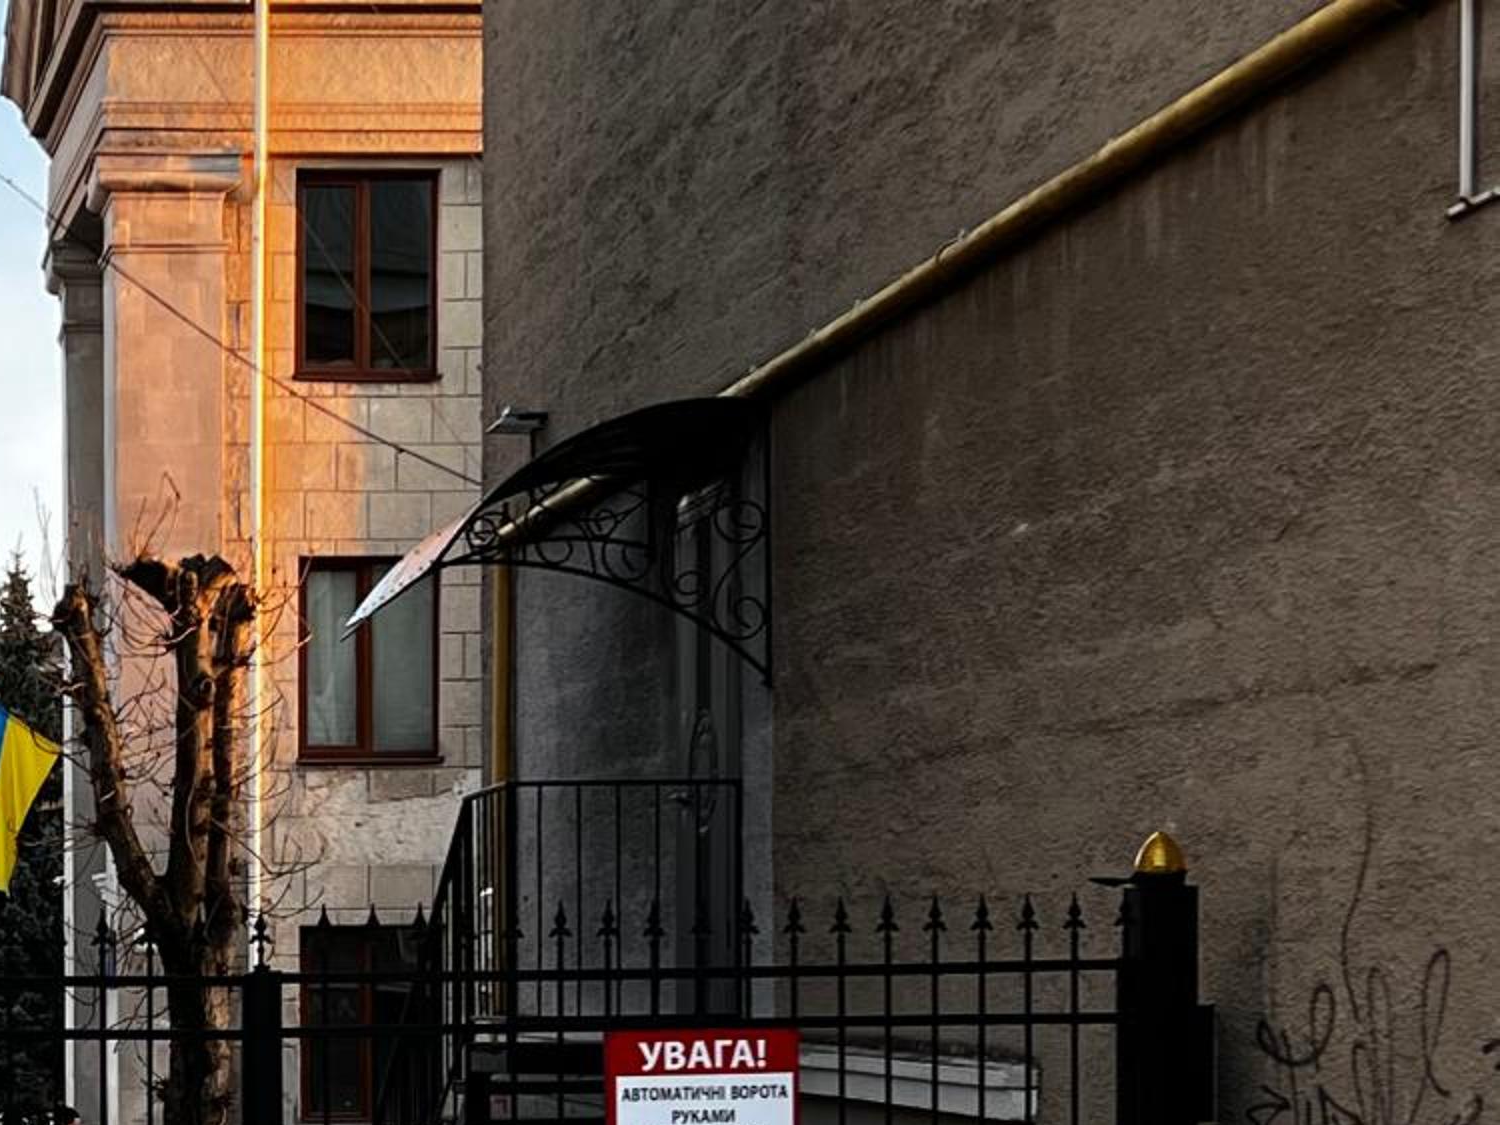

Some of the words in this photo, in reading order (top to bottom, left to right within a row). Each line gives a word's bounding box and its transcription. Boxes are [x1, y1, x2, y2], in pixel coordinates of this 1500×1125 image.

[638, 1039, 767, 1071] УВАГА!
[621, 1085, 726, 1102] АВТОМАТИЧНІ
[731, 1084, 788, 1100] ВОРОТА
[671, 1109, 736, 1124] РУКАМИ
